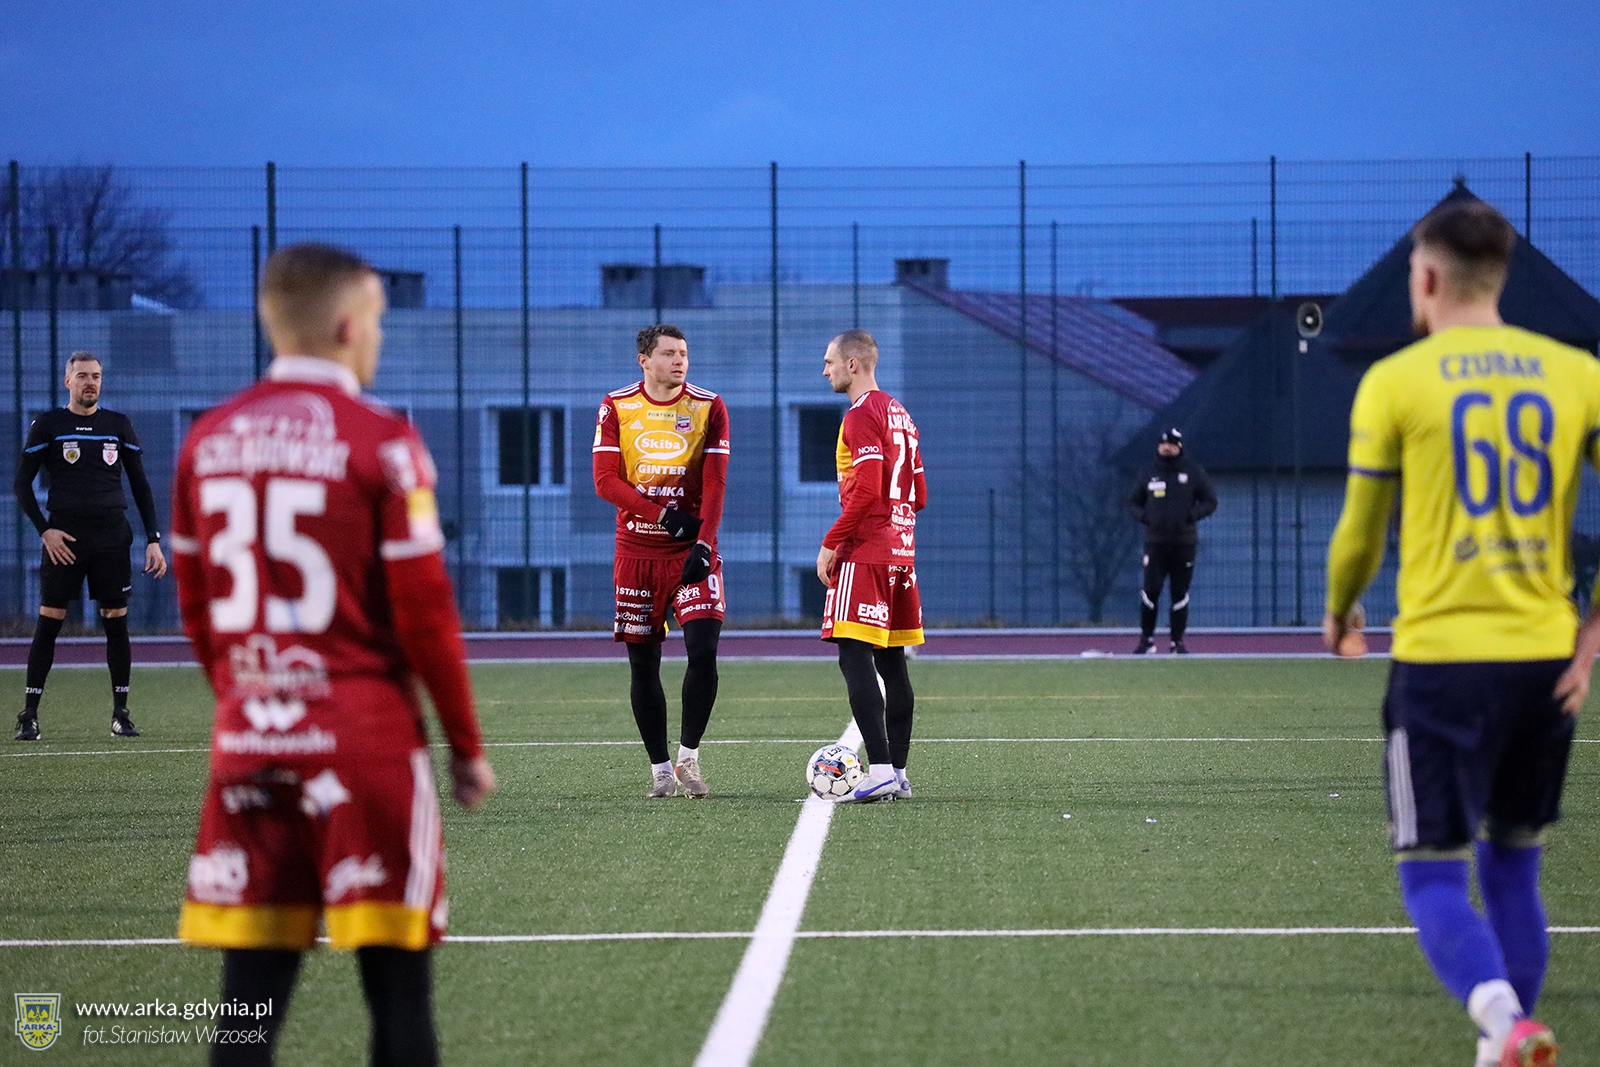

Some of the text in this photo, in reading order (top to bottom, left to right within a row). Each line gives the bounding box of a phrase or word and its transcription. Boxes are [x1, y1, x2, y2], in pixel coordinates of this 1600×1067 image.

[641, 438, 681, 450] Skiba
[1452, 391, 1554, 517] 68
[638, 465, 687, 476] GINTER
[647, 485, 684, 497] EMKA
[636, 521, 666, 530] EUROSTA
[199, 476, 337, 634] 35
[619, 587, 652, 598] STAPOL
[708, 574, 720, 599] 9
